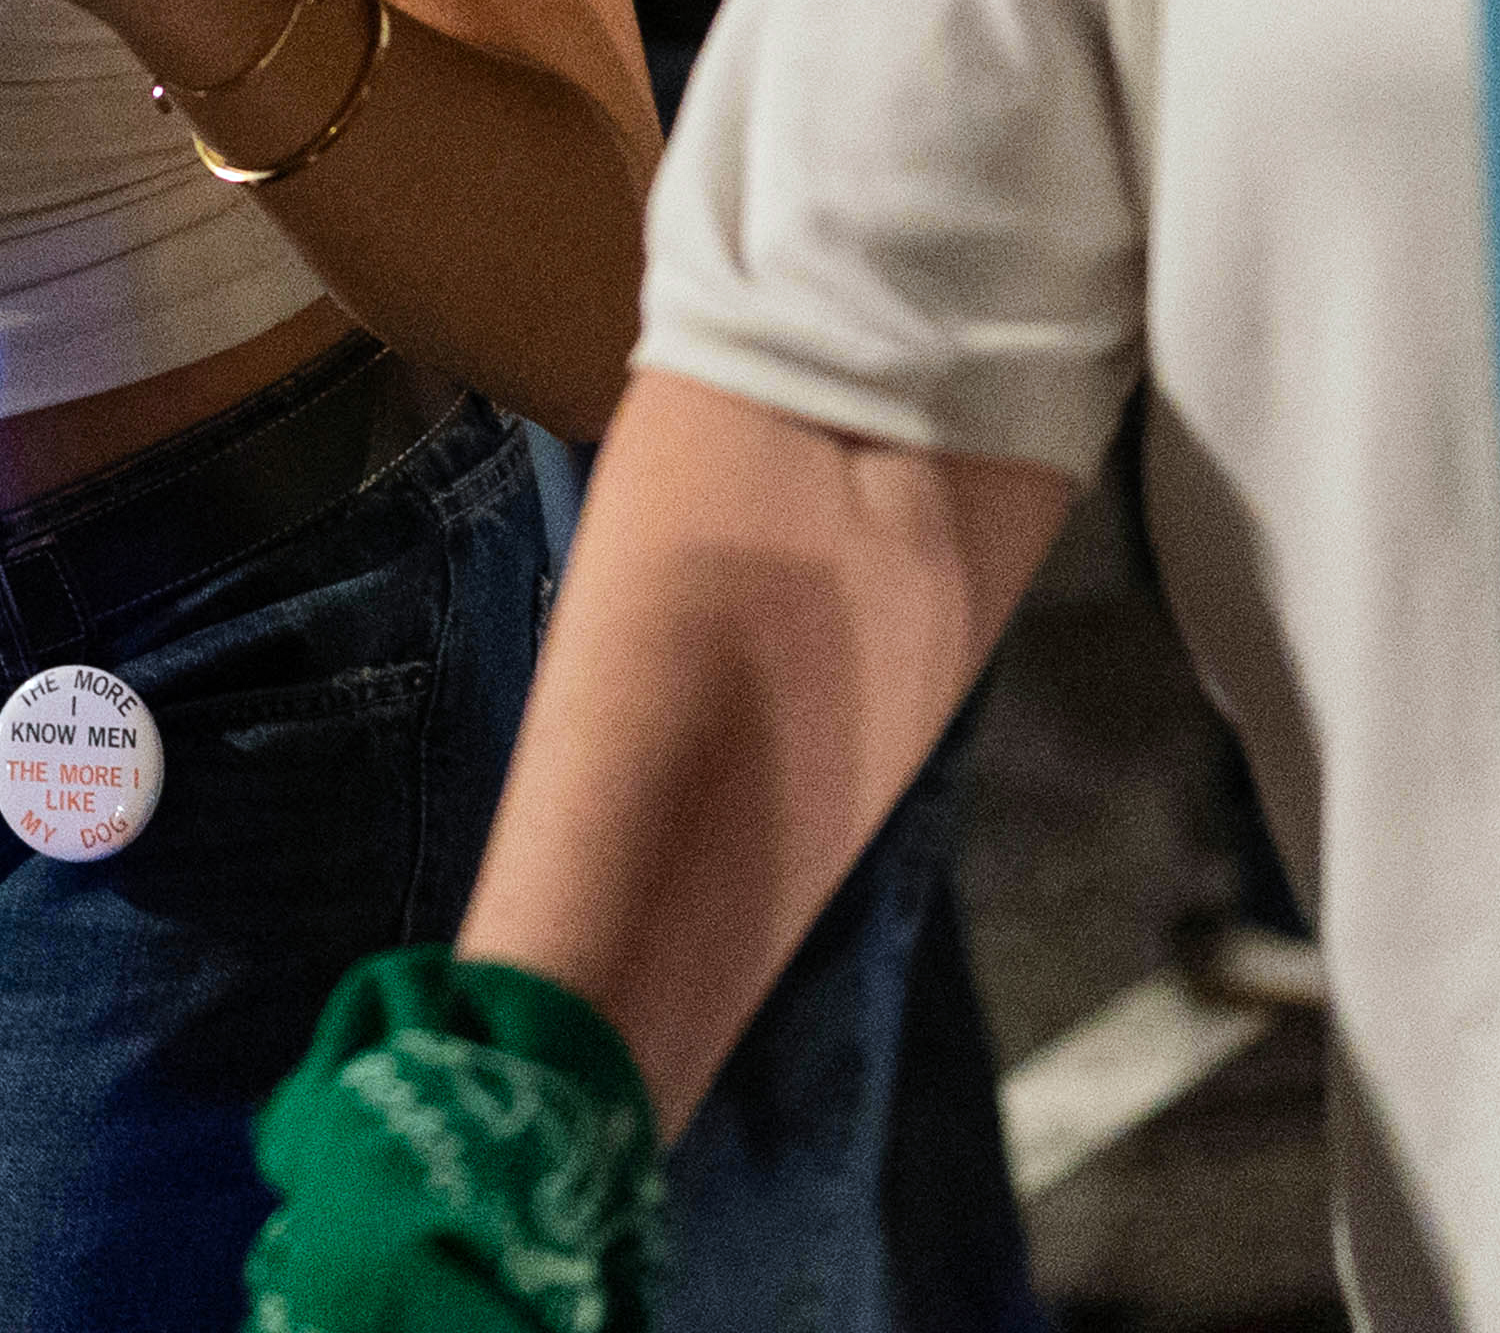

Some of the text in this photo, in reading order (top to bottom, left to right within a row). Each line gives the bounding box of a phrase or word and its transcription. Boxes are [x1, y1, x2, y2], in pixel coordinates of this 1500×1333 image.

[20, 669, 138, 718] THE MORE
[71, 695, 77, 716] I
[11, 721, 137, 749] KNOW MEN
[7, 760, 140, 789] THE MORE I
[45, 789, 96, 813] LIKE
[20, 809, 129, 849] MY DOG
